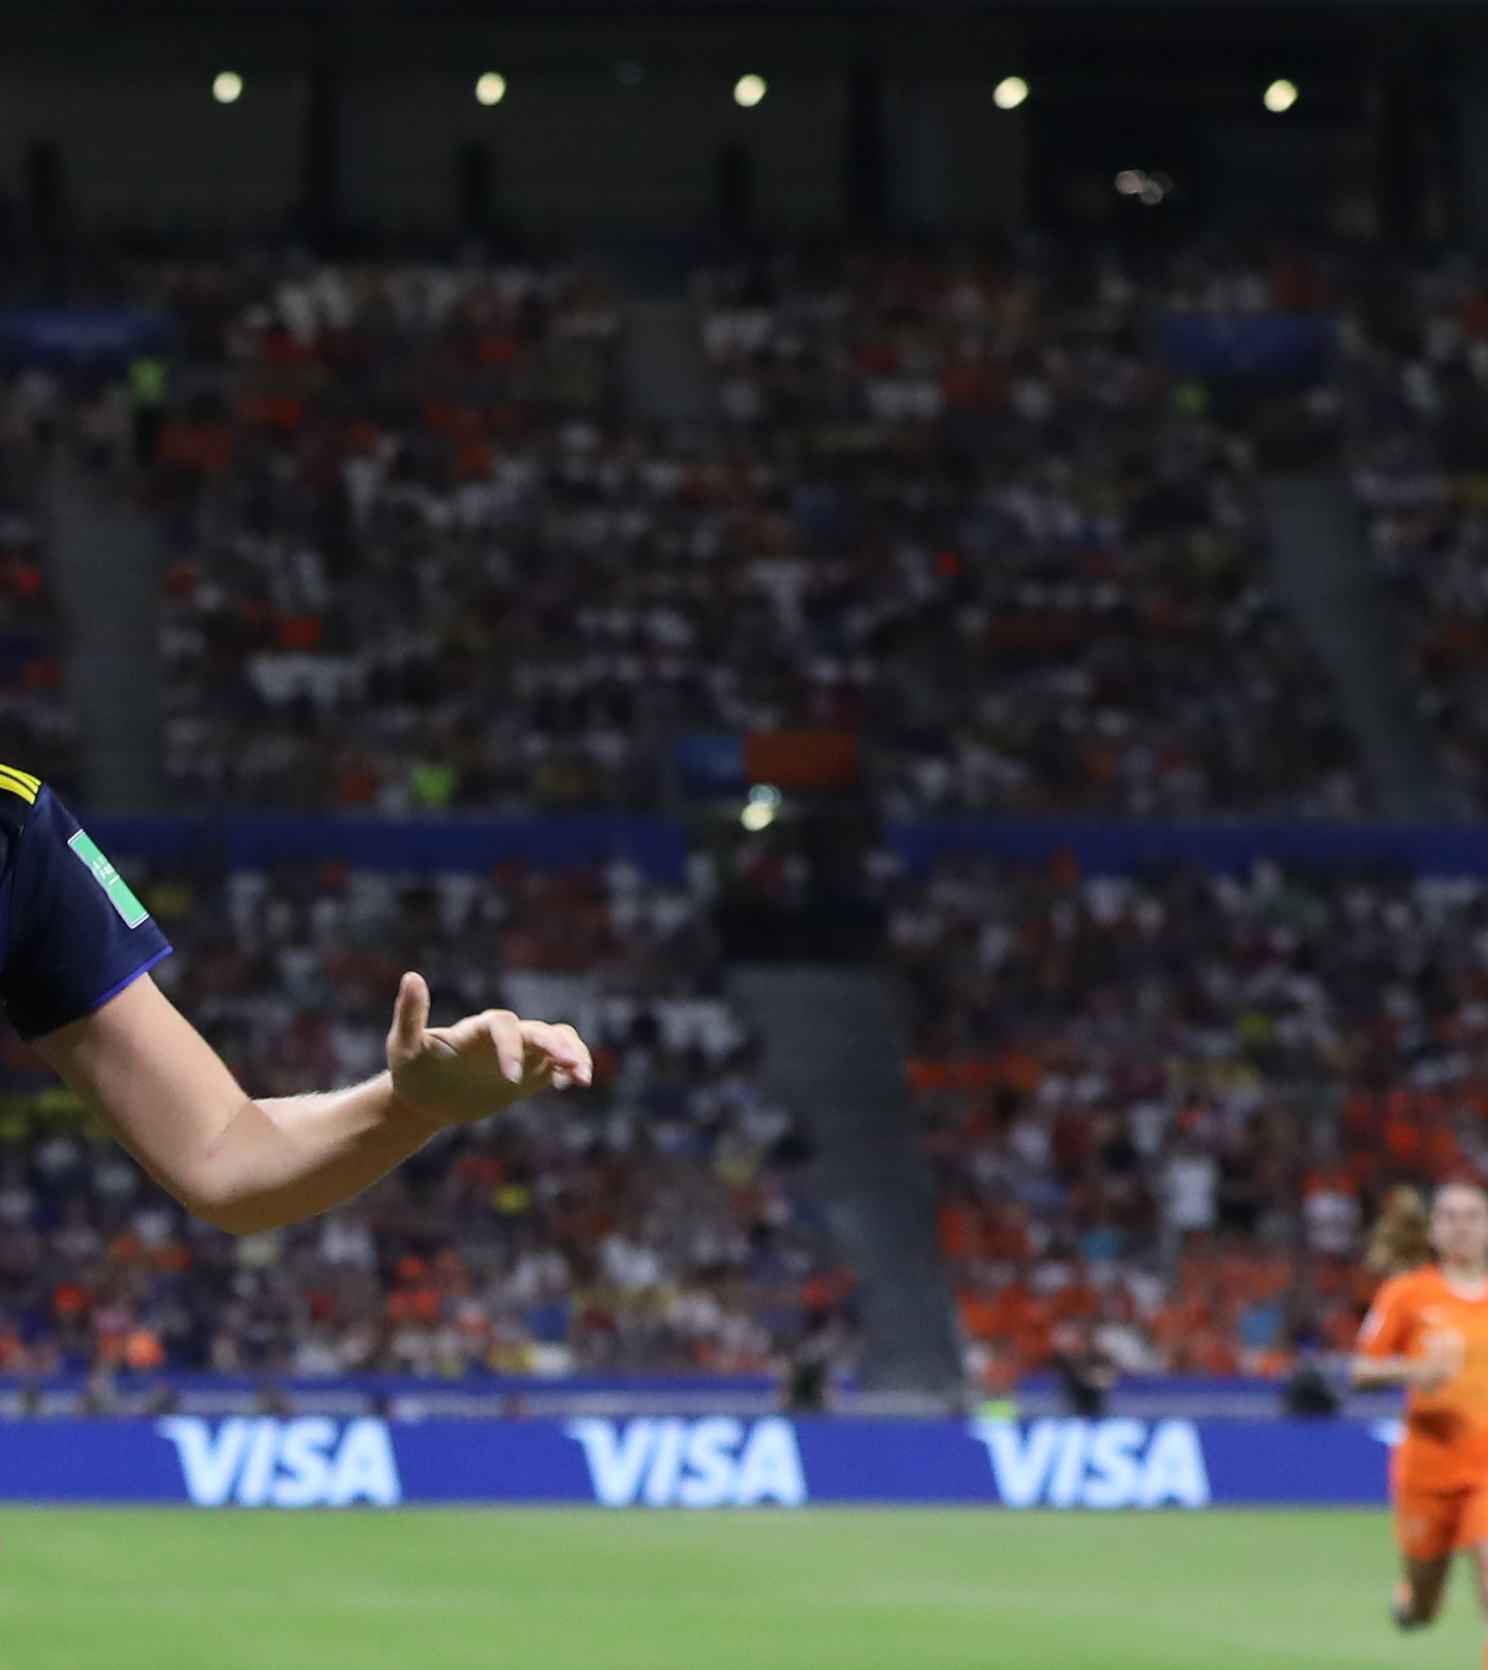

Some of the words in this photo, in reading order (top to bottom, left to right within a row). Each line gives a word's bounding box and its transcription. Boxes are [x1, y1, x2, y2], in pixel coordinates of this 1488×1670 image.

[160, 1415, 402, 1507] VISA
[564, 1415, 809, 1507] VISA
[969, 1415, 1212, 1508] VISA
